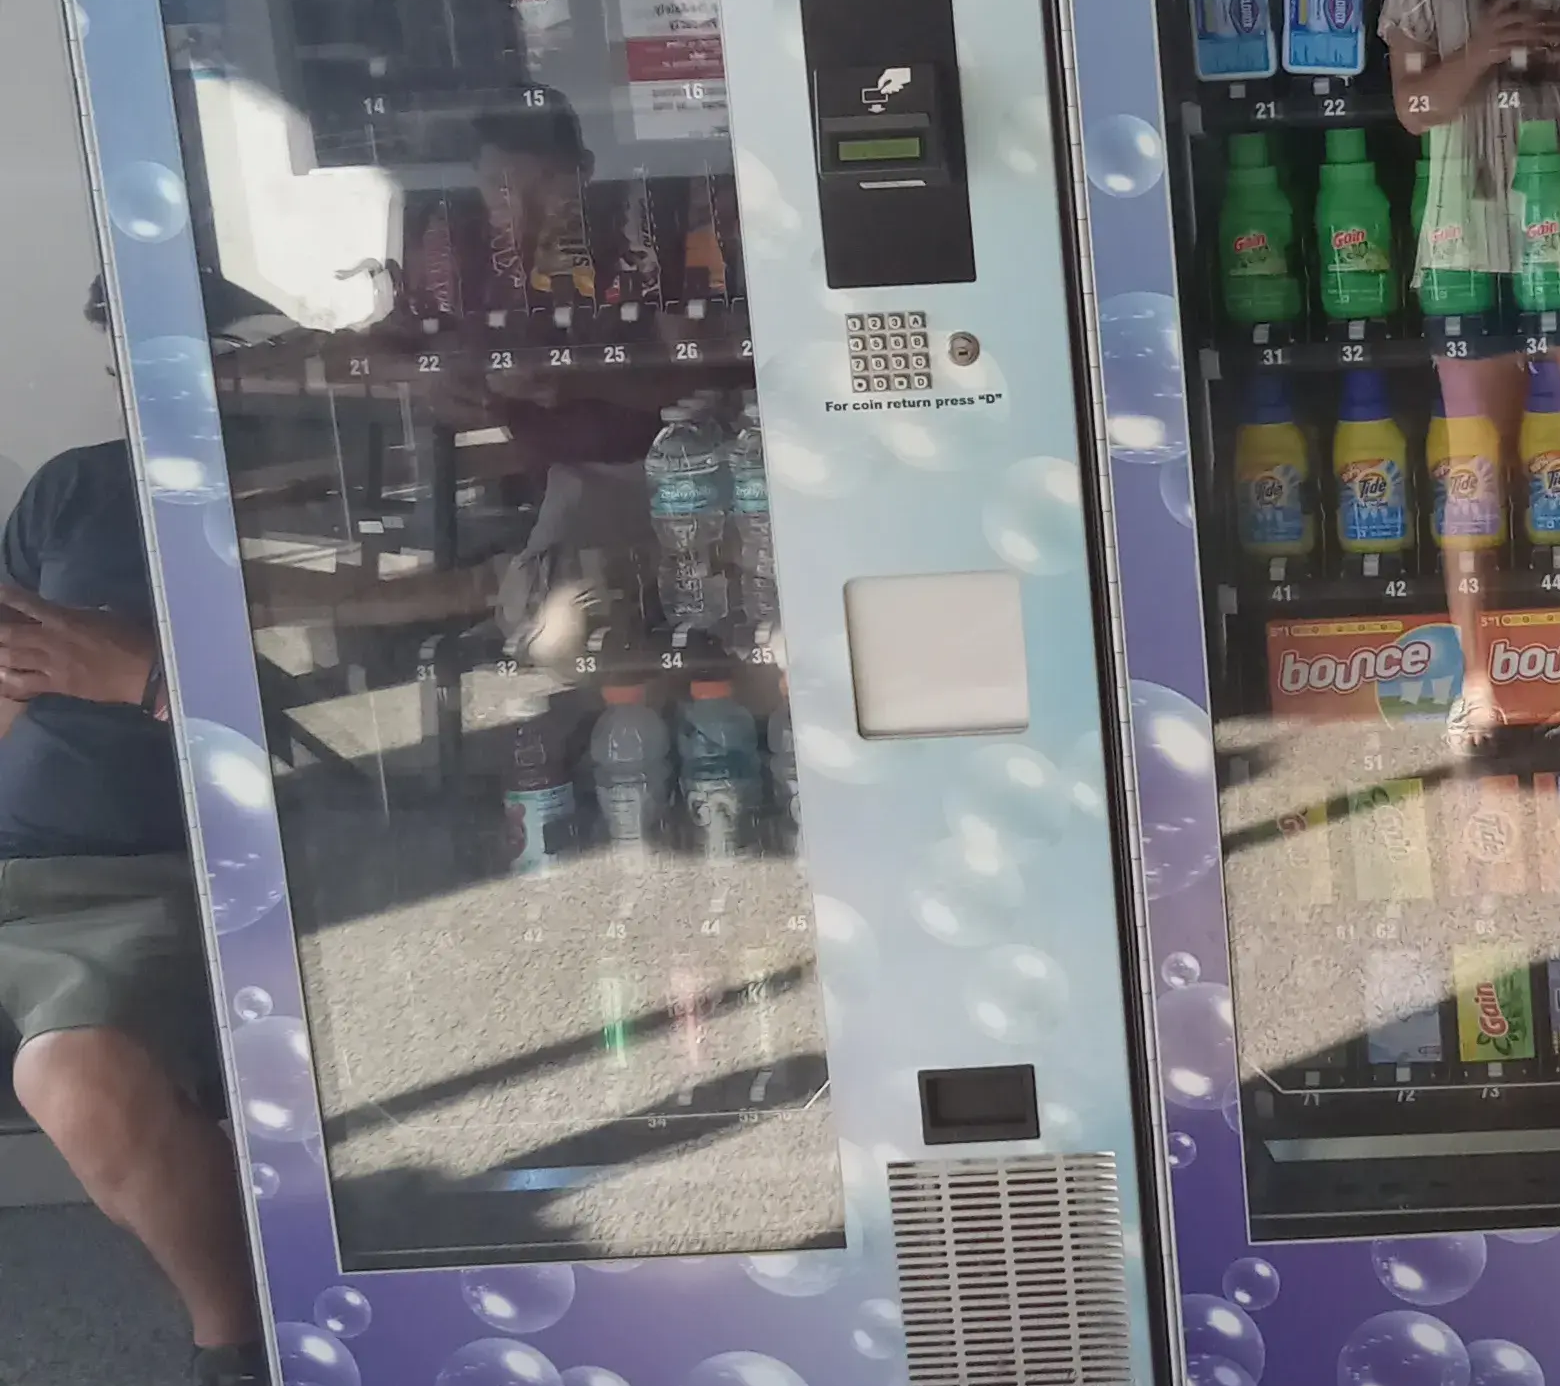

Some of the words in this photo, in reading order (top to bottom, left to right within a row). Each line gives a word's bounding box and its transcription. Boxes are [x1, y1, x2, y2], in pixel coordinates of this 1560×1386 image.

[523, 90, 545, 108] 15
[682, 82, 704, 100] 16
[364, 98, 386, 116] 14
[1255, 100, 1276, 119] 21
[1324, 99, 1346, 117] 22
[1408, 95, 1431, 113] 23
[1498, 91, 1520, 109] 24
[350, 359, 370, 376] 21
[418, 355, 441, 373] 22
[491, 352, 514, 370] 23
[550, 349, 572, 367] 24
[604, 346, 626, 364] 25
[676, 342, 698, 361] 26
[741, 339, 753, 357] 2
[1263, 348, 1284, 366] 31
[1342, 344, 1365, 362] 32
[1446, 341, 1468, 358] 33
[1526, 337, 1548, 355] 34
[825, 401, 848, 412] For
[852, 398, 883, 411] coin
[886, 397, 931, 409] return
[935, 396, 975, 409] press
[1358, 477, 1387, 499] Tide
[1450, 471, 1478, 493] Tide
[1271, 585, 1292, 602] 41
[1385, 581, 1408, 598] 42
[1458, 577, 1480, 595] 43
[416, 664, 437, 682] 31
[497, 660, 518, 678] 32
[576, 656, 597, 674] 33
[661, 651, 684, 669] 34
[752, 647, 774, 665] 35
[1278, 641, 1431, 695] bounce
[1363, 755, 1384, 771] 51
[605, 921, 626, 939] 43
[700, 919, 720, 935] 44
[787, 915, 807, 931] 45
[1376, 924, 1396, 939] 62
[1474, 980, 1510, 1037] Gain
